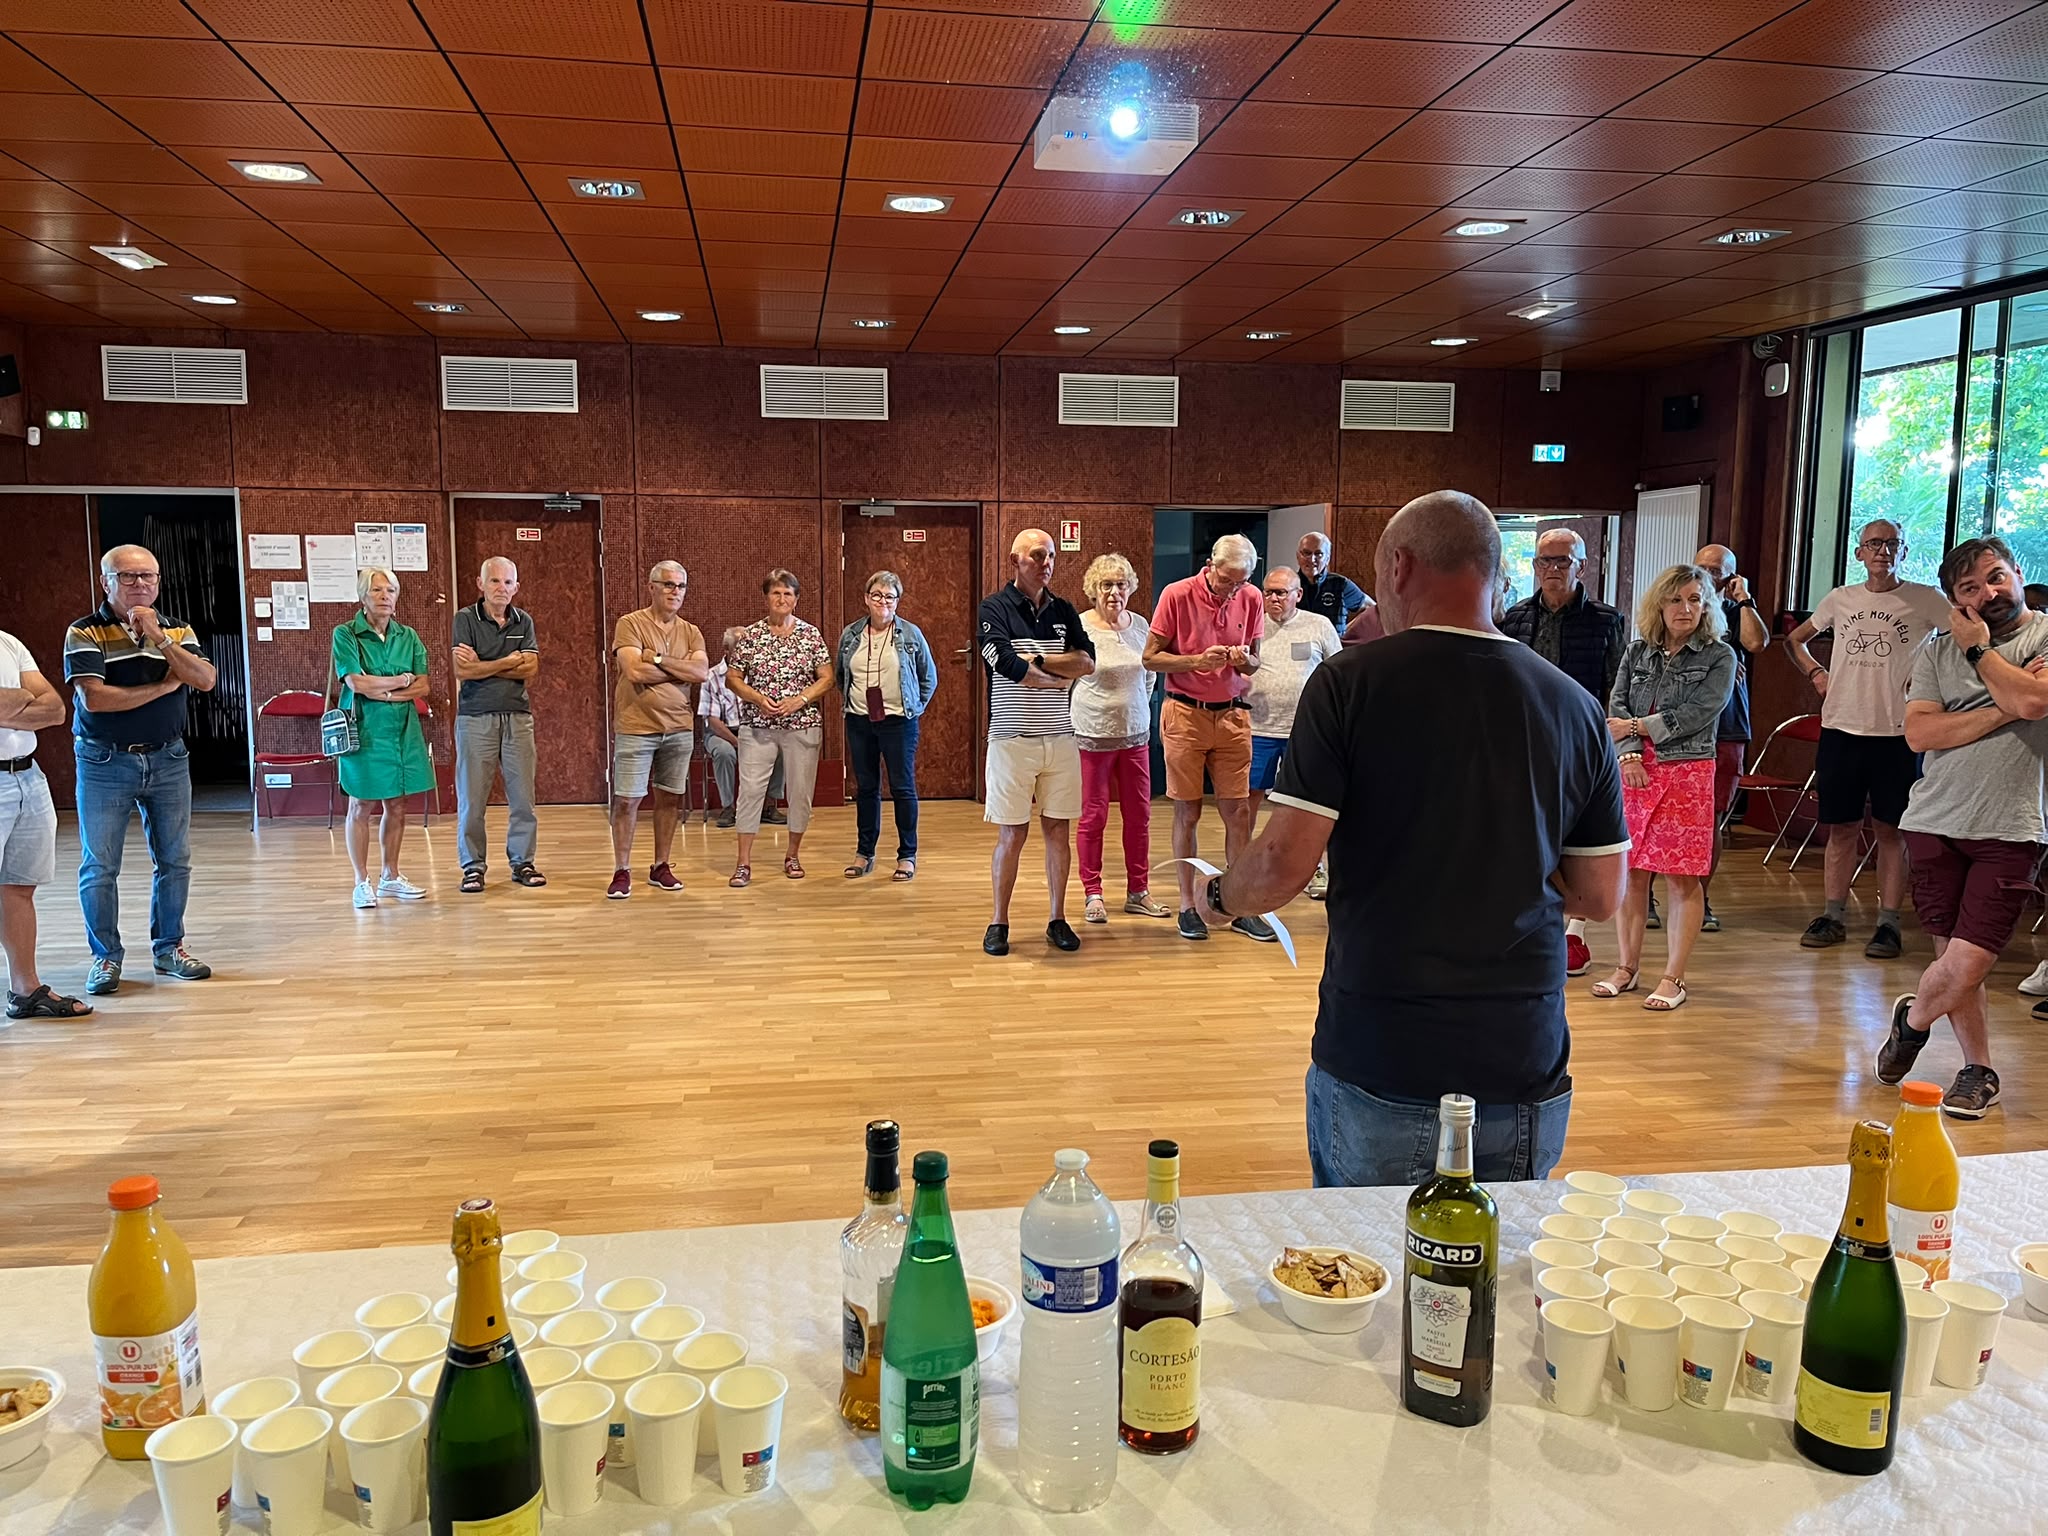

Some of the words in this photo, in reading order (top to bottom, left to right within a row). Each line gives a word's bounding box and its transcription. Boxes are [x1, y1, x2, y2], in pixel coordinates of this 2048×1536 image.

[1840, 611, 1864, 639] J'AIME
[1870, 610, 1893, 622] MON
[1893, 618, 1909, 644] VÉLO
[1934, 1219, 1944, 1229] U
[1408, 1234, 1475, 1262] RICARD
[123, 1346, 136, 1358] U
[1130, 1346, 1200, 1366] CORTESÃO
[1149, 1373, 1187, 1383] PORTO
[1150, 1382, 1186, 1390] BLANC
